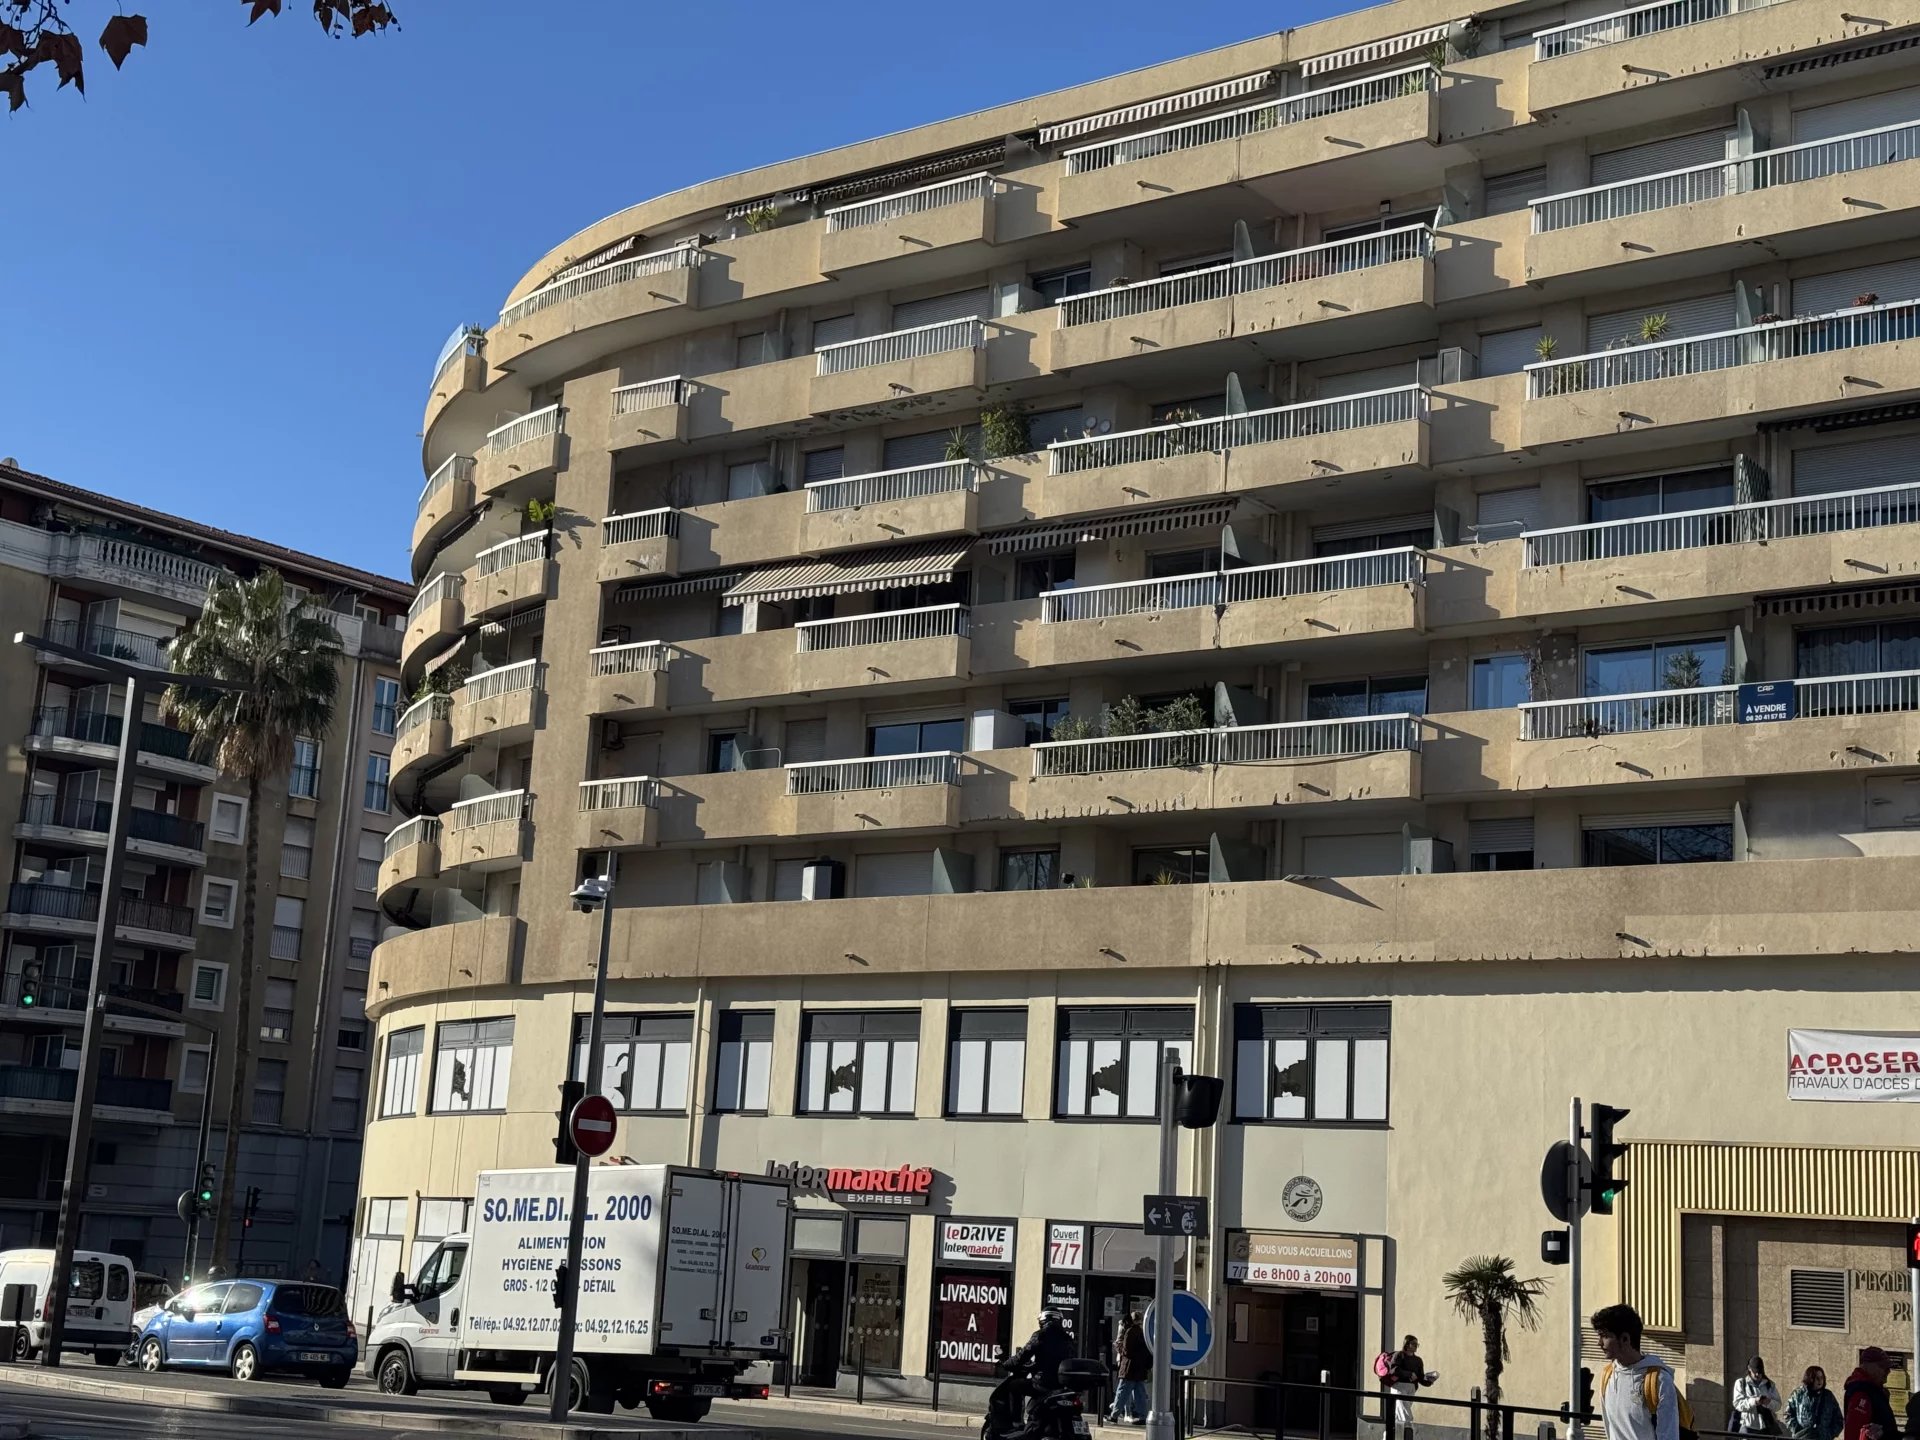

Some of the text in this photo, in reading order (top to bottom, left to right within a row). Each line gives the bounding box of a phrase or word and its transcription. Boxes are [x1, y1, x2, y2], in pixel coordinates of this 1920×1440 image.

[1746, 703, 1787, 714] À VENDRE
[1790, 1076, 1849, 1090] TRAVAUX
[1853, 1074, 1910, 1090] D'ACCÈS
[847, 1193, 912, 1205] EXPRESS
[483, 1194, 652, 1222] SO.ME.DI.L. 2000
[1052, 1228, 1079, 1240] Ouvert
[518, 1236, 606, 1250] ALIMENTION
[944, 1242, 1004, 1257] Intermarché
[1050, 1242, 1081, 1266] 7/7
[1255, 1244, 1276, 1255] NOUS
[1277, 1245, 1298, 1256] VOUS
[1299, 1246, 1353, 1259] ACCUEILLONS
[501, 1255, 554, 1271] HYGIÈNE
[1232, 1265, 1352, 1284] 7/7 de 8h00 à 20h00
[503, 1278, 528, 1292] GROS
[536, 1279, 549, 1292] 1/2
[583, 1276, 616, 1293] DÉTAIL
[1051, 1283, 1076, 1295] Tous les
[939, 1283, 1008, 1306] LIVRAISON
[1047, 1294, 1080, 1306] Dimanches
[585, 1319, 649, 1335] 04.92.12.16.25
[966, 1313, 978, 1332] A
[939, 1340, 1002, 1363] DOMICILE
